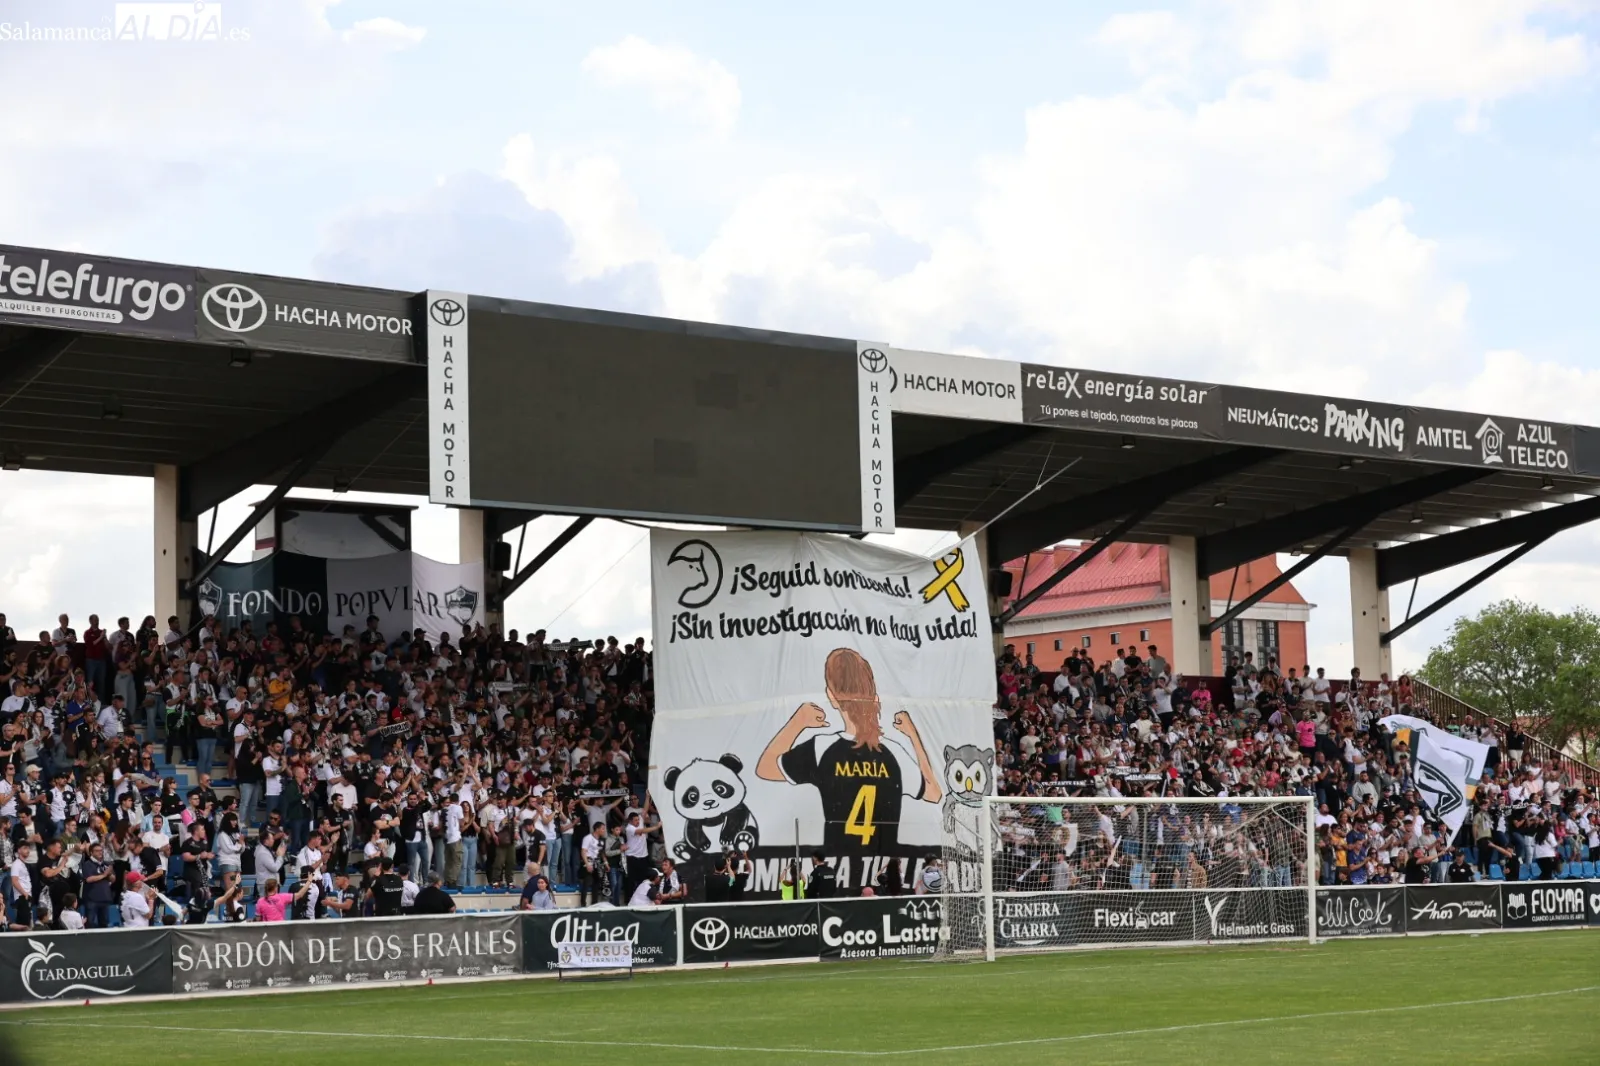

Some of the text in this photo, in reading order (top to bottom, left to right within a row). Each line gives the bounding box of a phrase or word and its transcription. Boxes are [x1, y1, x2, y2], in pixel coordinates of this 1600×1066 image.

[45, 306, 56, 314] DE
[59, 308, 117, 320] FURGONETAS
[275, 305, 413, 336] HACHA MOTOR
[904, 373, 1016, 399] HACHA MOTOR
[1084, 379, 1154, 402] energía
[1159, 384, 1208, 404] solar
[442, 335, 456, 498] HACHA MOTOR
[1053, 407, 1080, 418] pones
[1081, 409, 1089, 418] el
[1227, 403, 1405, 451] NEUMÁTICOS PARKING
[1416, 426, 1472, 450] AMTEL
[1516, 423, 1557, 445] AZUL
[870, 381, 883, 528] HACHA MOTOR
[1508, 445, 1568, 469] TELECO
[227, 586, 321, 617] FONDO
[670, 611, 714, 643] ¡Sin
[866, 615, 887, 637] no
[890, 614, 921, 648] hay
[926, 611, 977, 642] vida!
[835, 759, 889, 778] MARÍA
[844, 784, 877, 845] 4
[996, 899, 1060, 918] TERNERA
[1531, 888, 1585, 915] FLOYMA
[734, 923, 818, 940] HACHA MOTOR
[822, 917, 877, 947] Coco
[1000, 919, 1059, 938] CHARRA
[1219, 922, 1295, 936] Helmantic Grass
[178, 930, 516, 972] SARDÓN DE LOS FRAILES
[573, 945, 630, 957] VERSUS
[840, 945, 935, 959] Asesora Inmobiliaria
[36, 964, 134, 982] TARDAGUILA
